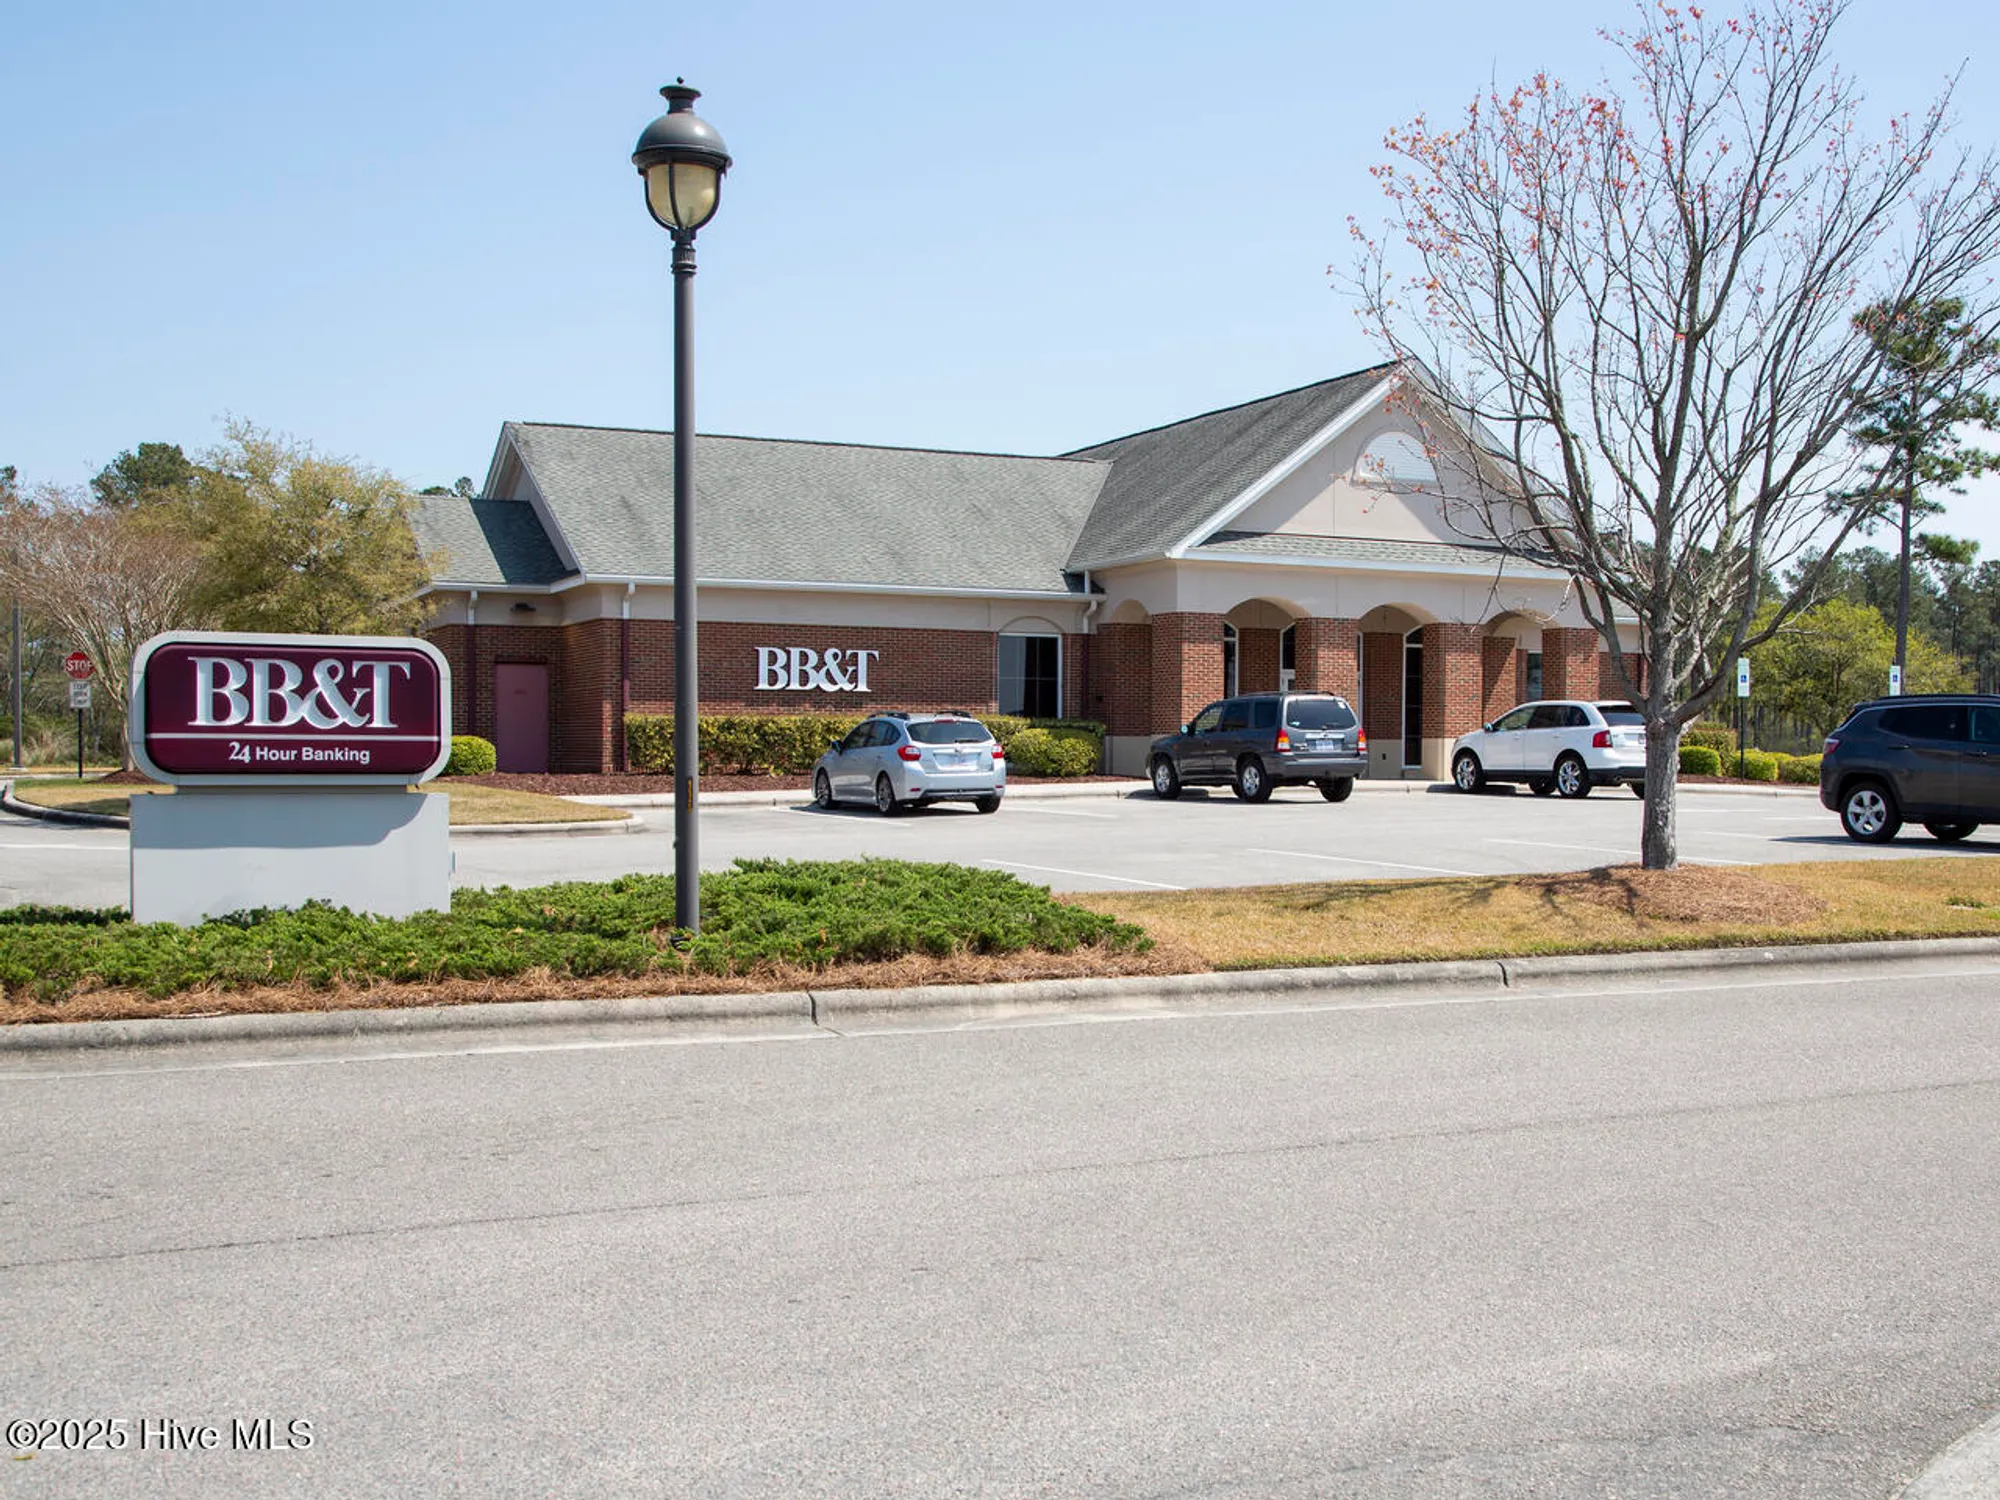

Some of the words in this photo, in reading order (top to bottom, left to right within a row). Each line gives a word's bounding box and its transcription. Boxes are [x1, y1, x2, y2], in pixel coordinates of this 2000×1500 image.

[754, 646, 879, 692] BB&T
[187, 656, 411, 729] BB&T
[229, 741, 251, 763] 24
[255, 746, 298, 761] Hour
[302, 746, 370, 764] Banking
